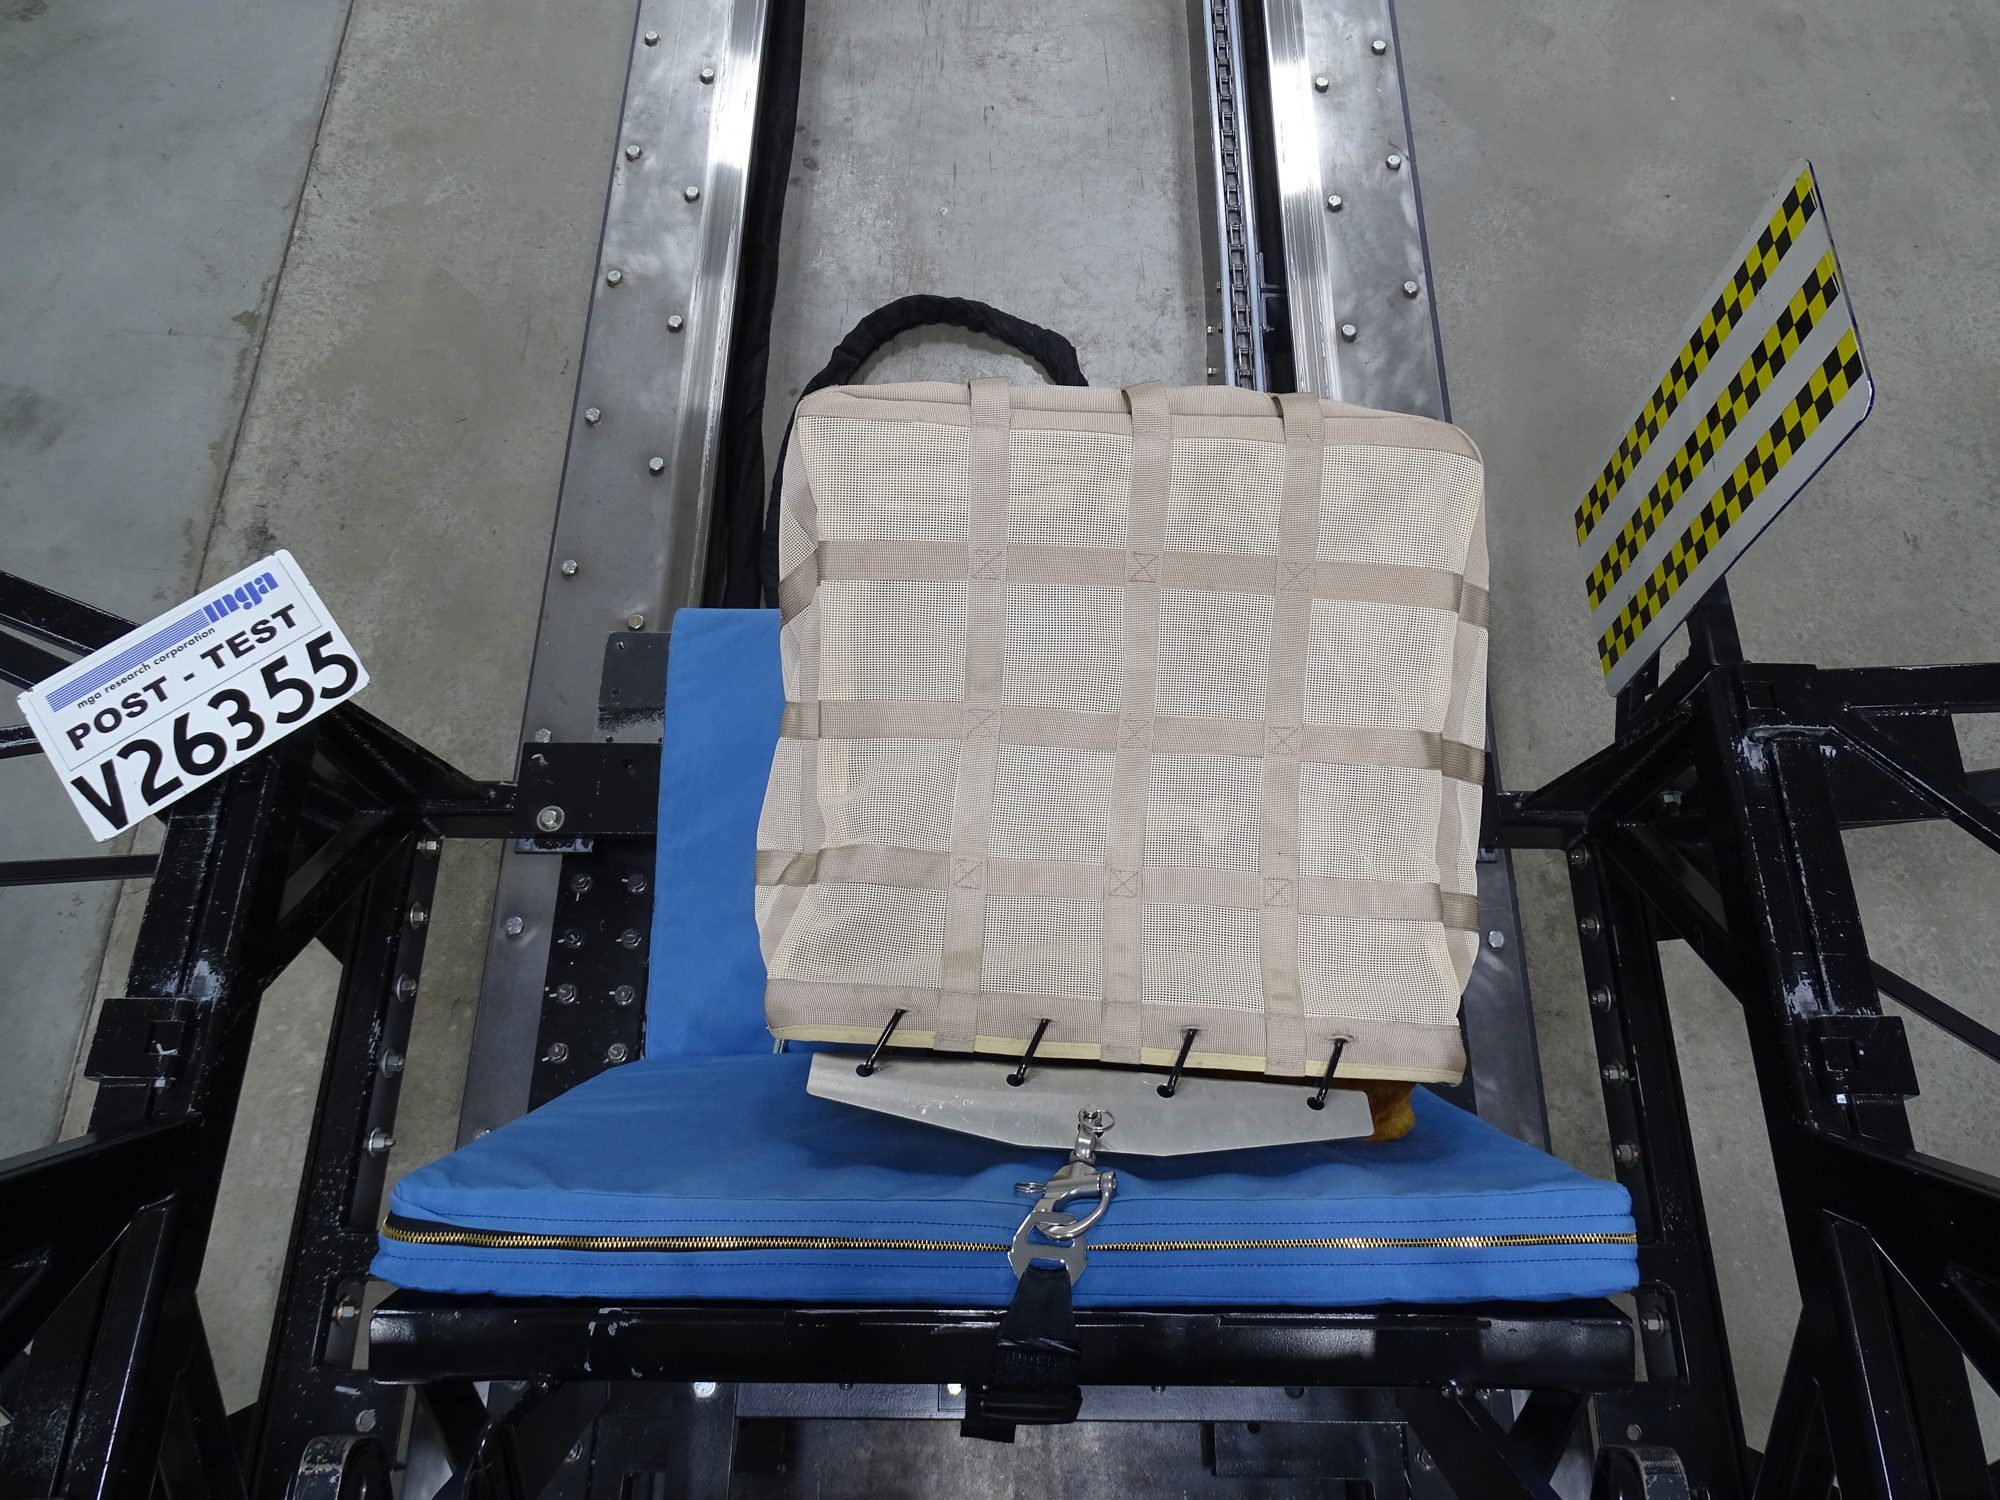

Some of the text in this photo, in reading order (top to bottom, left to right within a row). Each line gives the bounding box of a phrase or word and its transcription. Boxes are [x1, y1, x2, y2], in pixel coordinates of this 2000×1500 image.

[202, 571, 279, 624] mga
[65, 676, 171, 751] POST
[200, 603, 296, 670] TEST
[77, 626, 216, 710] mga research corporation
[71, 631, 359, 831] V26355
